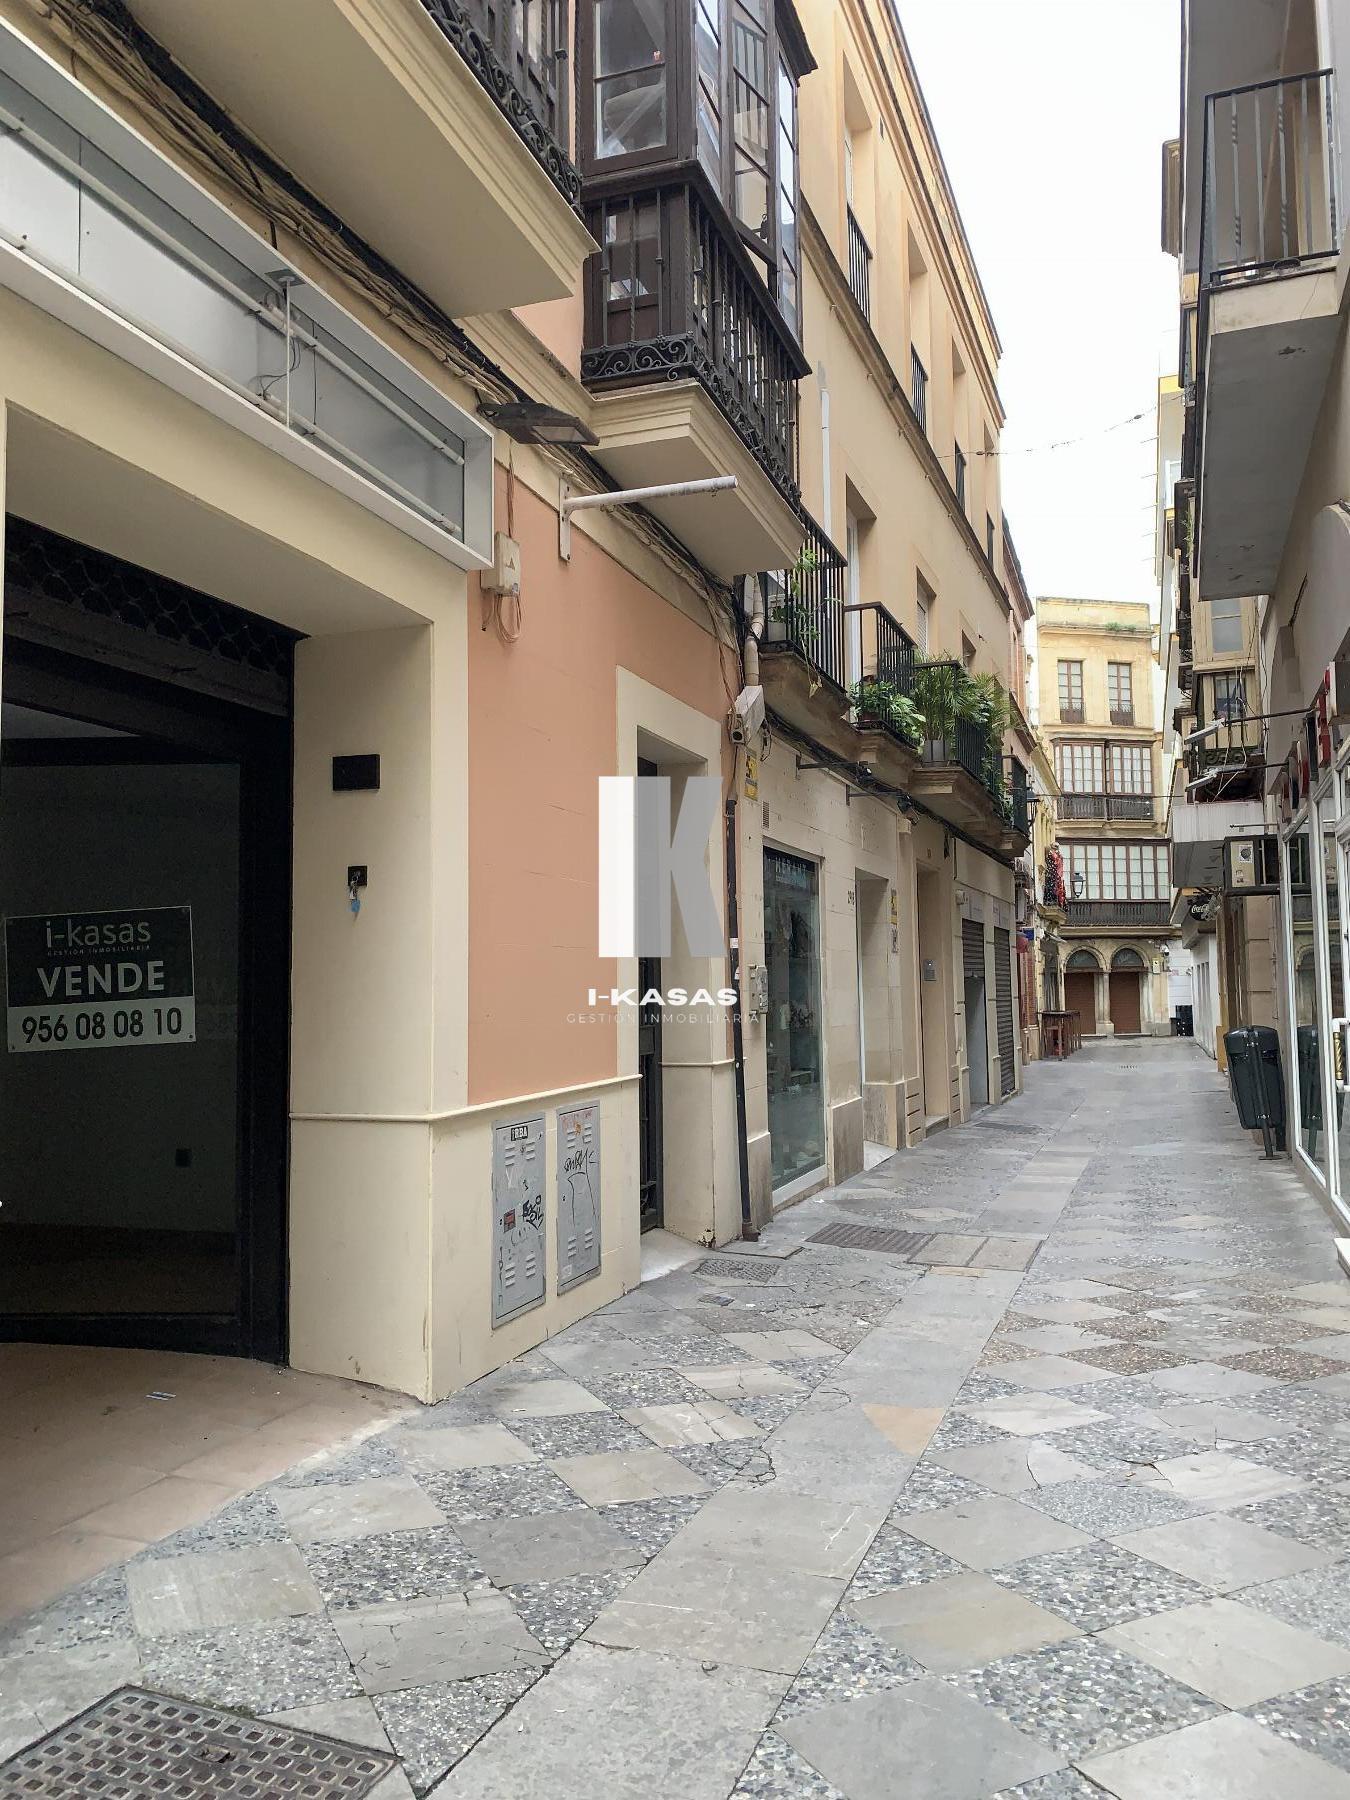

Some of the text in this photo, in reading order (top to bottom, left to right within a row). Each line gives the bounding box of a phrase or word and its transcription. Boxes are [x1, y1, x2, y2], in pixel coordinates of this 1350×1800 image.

[46, 919, 151, 948] i-kasas
[37, 960, 165, 998] VENDE
[22, 1007, 182, 1044] 956 08 08 10
